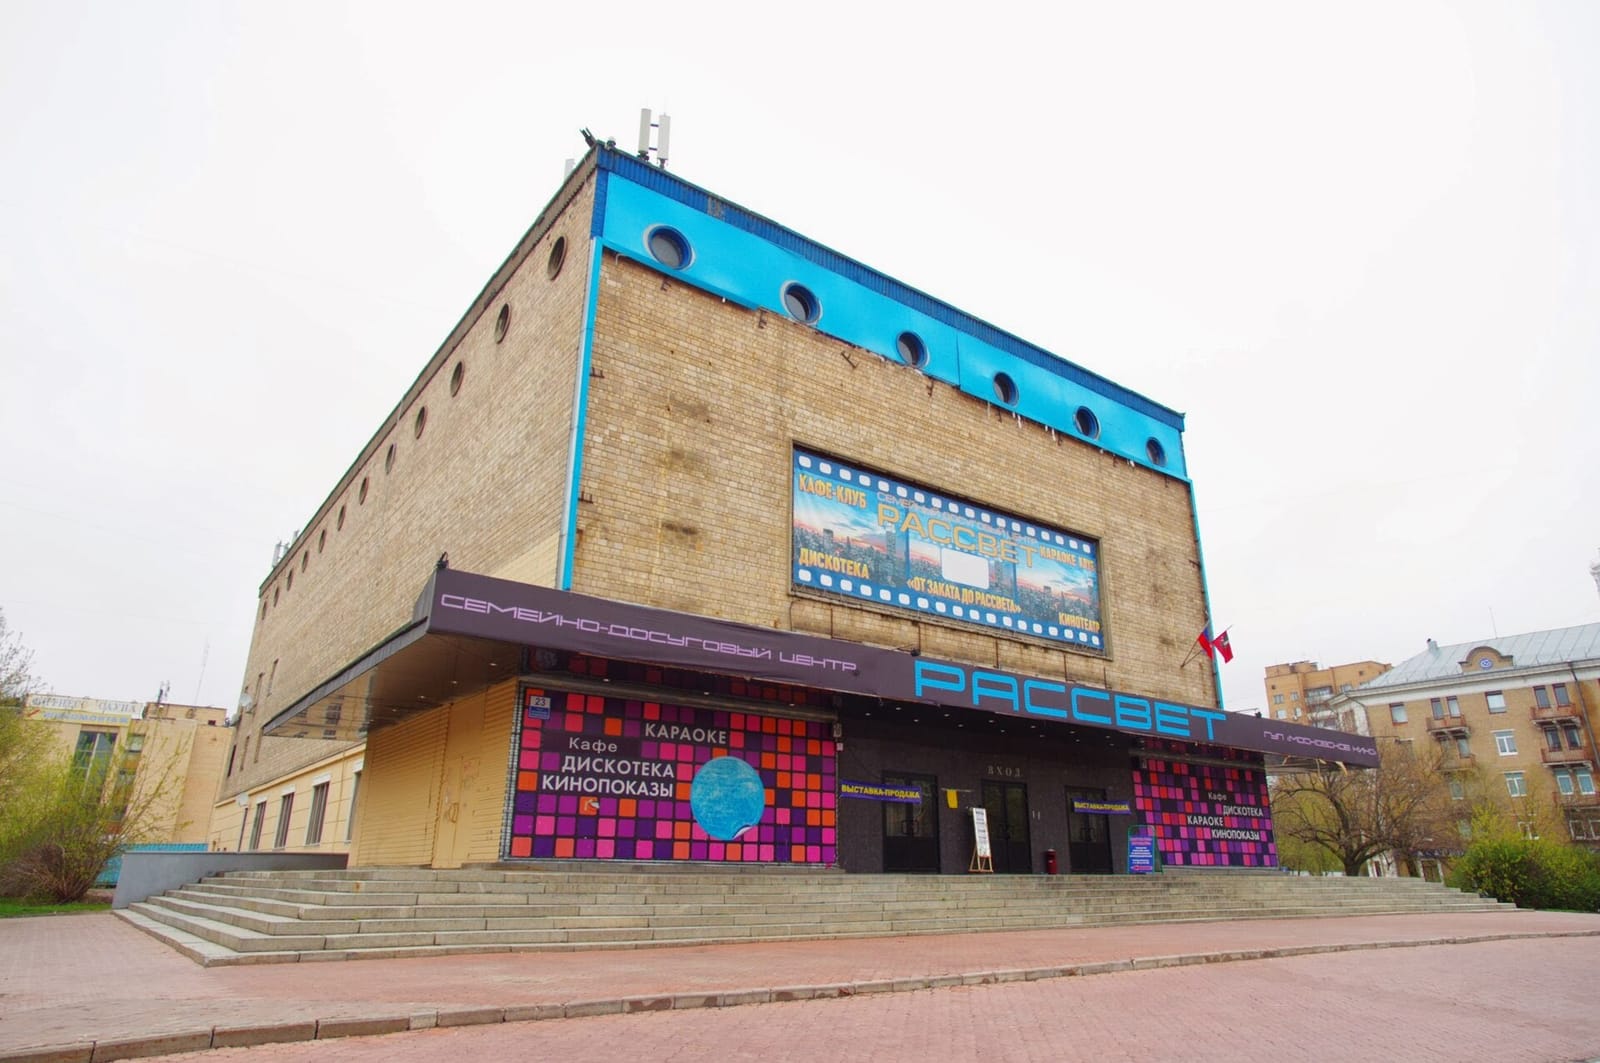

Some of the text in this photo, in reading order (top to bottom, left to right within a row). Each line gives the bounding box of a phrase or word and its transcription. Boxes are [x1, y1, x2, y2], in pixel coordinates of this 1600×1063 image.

[799, 473, 867, 508] КАФЕ-КЛУБ
[877, 503, 1038, 568] РАССВЕТ
[799, 547, 869, 579] ДИСКОТЕКА
[1040, 544, 1076, 566] КАРАОКЕ
[927, 579, 960, 601] ЗАКАТА
[961, 588, 974, 605] ДО
[441, 593, 857, 672] СЕМЕЙНО-ДОСУГОВЫЙ ЦЕНТР
[1058, 611, 1100, 633] КИНОТЕАТР
[535, 697, 546, 706] 23
[914, 659, 1227, 740] РАССВЕТ
[645, 723, 727, 745] КАРАОКЕ
[569, 737, 618, 754] Кафе
[562, 755, 675, 779] ДИСКОТЕКА
[987, 765, 1022, 778] ВХОД
[542, 775, 674, 798] КИНОПОКАЗЫ
[841, 784, 920, 799] ВЫСТАВКА-ПРОДАЖА
[1208, 791, 1227, 802] Кафе
[1187, 815, 1223, 826] КАРАОКЕ
[1222, 804, 1264, 817] ДИСКОТЕКА
[1211, 828, 1260, 841] КИНОПОКАЗЫ
